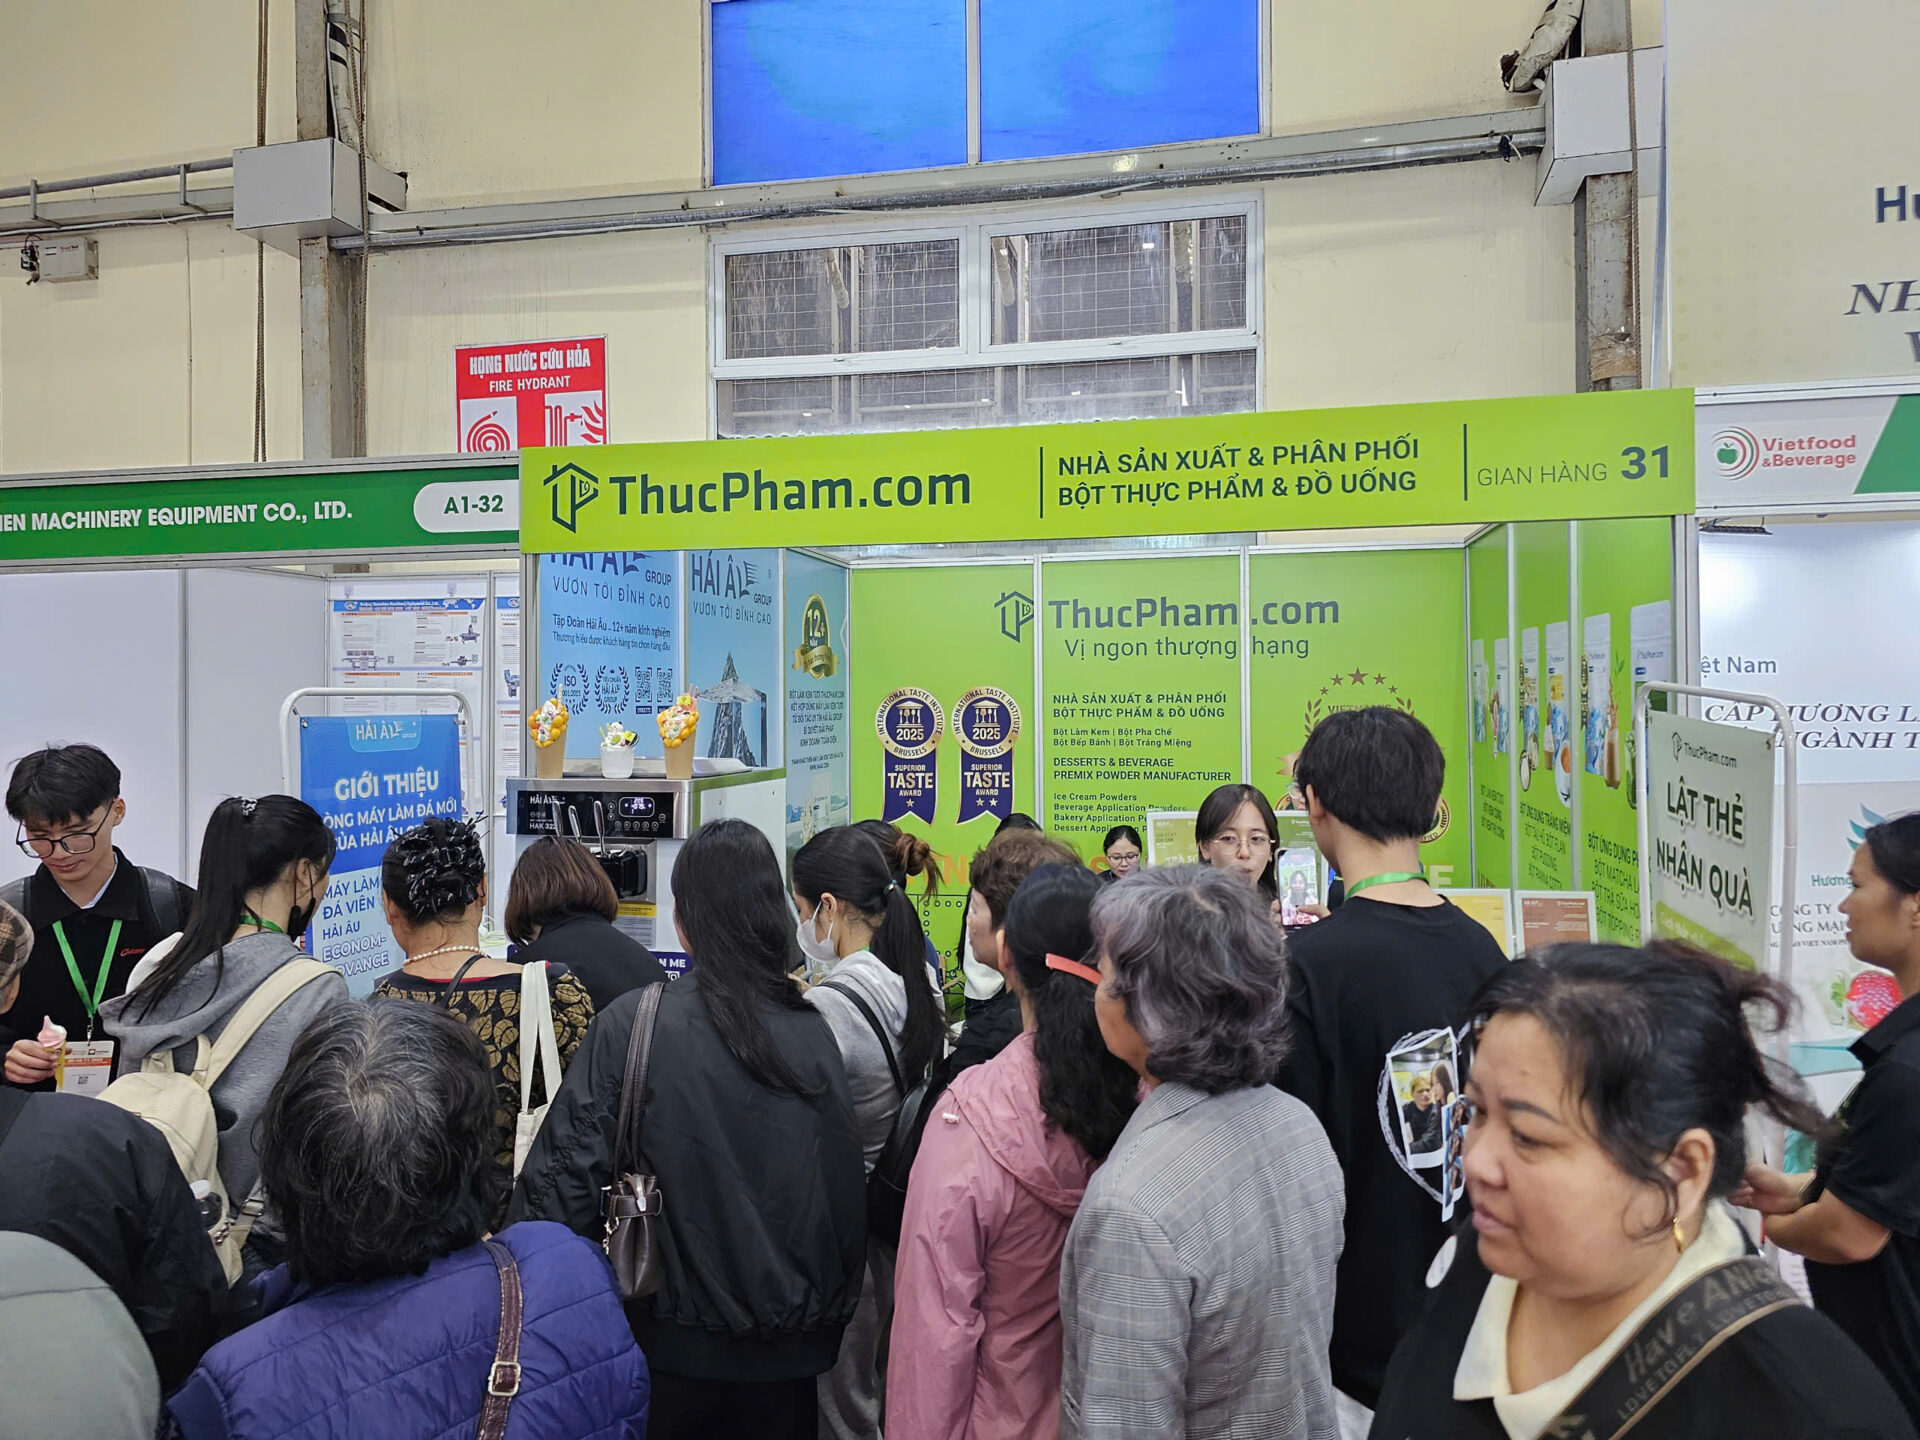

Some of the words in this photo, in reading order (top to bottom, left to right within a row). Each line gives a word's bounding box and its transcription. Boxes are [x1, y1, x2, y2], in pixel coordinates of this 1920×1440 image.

[469, 354, 502, 379] HỌNG
[565, 343, 591, 368] HỎA
[489, 379, 513, 392] FIRE
[517, 375, 571, 390] HYDRANT
[1763, 434, 1856, 452] Vietfood
[1058, 450, 1110, 476] NHÀ
[1117, 447, 1166, 473] SẢN
[1175, 442, 1241, 471] XUẤT
[1247, 446, 1265, 467] &
[1272, 438, 1347, 465] PHÂN
[1354, 432, 1419, 462] PHỐI
[1762, 453, 1856, 468] &Beverage
[1477, 466, 1532, 486] GIAN
[1541, 460, 1608, 483] HÀNG
[1620, 445, 1669, 480] 31
[608, 469, 971, 515] ThucPham.com
[1058, 485, 1105, 510] BỘT
[1111, 482, 1180, 507] THỰC
[1187, 473, 1264, 501] PHẨM
[1271, 477, 1288, 497] &
[1295, 469, 1332, 495] ĐỒ
[1341, 466, 1416, 491] UỐNG
[443, 495, 504, 515] A1-32
[31, 508, 143, 531] MACHINERY
[148, 504, 257, 526] EQUIPMENT
[263, 502, 307, 523] CO.,
[314, 501, 352, 520] LTD.
[645, 569, 672, 586] GROUP
[649, 593, 671, 609] CAO
[753, 593, 772, 606] GROUP
[756, 611, 772, 625] CAO
[1048, 597, 1339, 628] ThucPham.com
[1065, 639, 1086, 660] Vị
[1094, 640, 1147, 660] ngon
[1155, 637, 1237, 659] thượng
[1252, 636, 1309, 658] hạng
[1727, 656, 1777, 674] Nam
[564, 675, 577, 687] ISO
[1053, 693, 1079, 704] NHÀ
[1083, 692, 1107, 704] SẢN
[1110, 691, 1142, 704] XUẤT
[1145, 694, 1153, 704] &
[1157, 691, 1193, 703] PHÂN
[1196, 690, 1227, 703] PHỐI
[877, 688, 907, 735] INTERNATIONAL
[909, 688, 930, 702] TASTE
[928, 699, 944, 736] INSTITUTE
[953, 687, 983, 734] INTERNATIONAL
[985, 687, 1006, 701] TASTE
[1004, 698, 1020, 735] INSTITUTE
[1053, 708, 1076, 720] BỘT
[1080, 708, 1112, 720] THỰC
[1116, 706, 1152, 718] PHẨM
[1156, 708, 1164, 718] &
[1168, 705, 1186, 718] ĐỒ
[1189, 704, 1225, 717] UỐNG
[896, 728, 925, 741] 2025
[972, 727, 1001, 740] 2025
[1053, 728, 1068, 737] Bột
[1070, 728, 1088, 736] Làm
[1091, 728, 1110, 736] Kem
[1117, 728, 1133, 737] Bột
[1135, 728, 1152, 736] Pha
[893, 746, 928, 757] BRUSSELS
[969, 745, 1004, 756] BRUSSELS
[1053, 738, 1068, 748] Bột
[1089, 738, 1111, 746] Bánh
[1119, 738, 1134, 748] Bột
[1137, 738, 1162, 748] Tráng
[1164, 738, 1192, 748] Miệng
[895, 764, 926, 772] SUPERIOR
[971, 763, 1002, 771] SUPERIOR
[1053, 757, 1106, 767] DESSERTS
[1108, 758, 1115, 767] &
[1118, 758, 1174, 767] BEVERAGE
[335, 770, 379, 801] GIỚI
[387, 766, 439, 798] THIỆU
[887, 772, 934, 789] TASTE
[963, 771, 1010, 788] TASTE
[1053, 771, 1093, 780] PREMIX
[1096, 771, 1140, 780] POWDER
[1143, 771, 1231, 781] MANUFACTURER
[899, 789, 922, 797] AWARD
[975, 788, 998, 796] AWARD
[1053, 793, 1067, 801] Ice
[1069, 793, 1097, 801] Cream
[1099, 793, 1138, 801] Powders
[323, 812, 354, 829] ÒNG
[357, 806, 386, 826] MÁY
[388, 803, 414, 822] LÀM
[416, 799, 435, 817] ĐÁ
[436, 796, 457, 815] MỚI
[1053, 803, 1094, 812] Beverage
[1096, 804, 1146, 813] Application
[1667, 775, 1698, 827] LẬT
[1703, 793, 1743, 840] THẺ
[1053, 813, 1084, 823] Bakery
[1086, 814, 1136, 824] Application
[360, 826, 383, 847] HẢI
[1053, 824, 1088, 832] Dessert
[353, 875, 380, 893] LÀM
[1656, 837, 1703, 891] NHẬN
[1709, 866, 1753, 917] QUÀ
[322, 901, 343, 920] ĐÁ
[346, 895, 375, 914] VIÊN
[1815, 903, 1831, 915] TY
[322, 923, 342, 940] HẢI
[345, 920, 360, 935] ÂU
[669, 958, 686, 968] ME
[1624, 1301, 1697, 1385] Have
